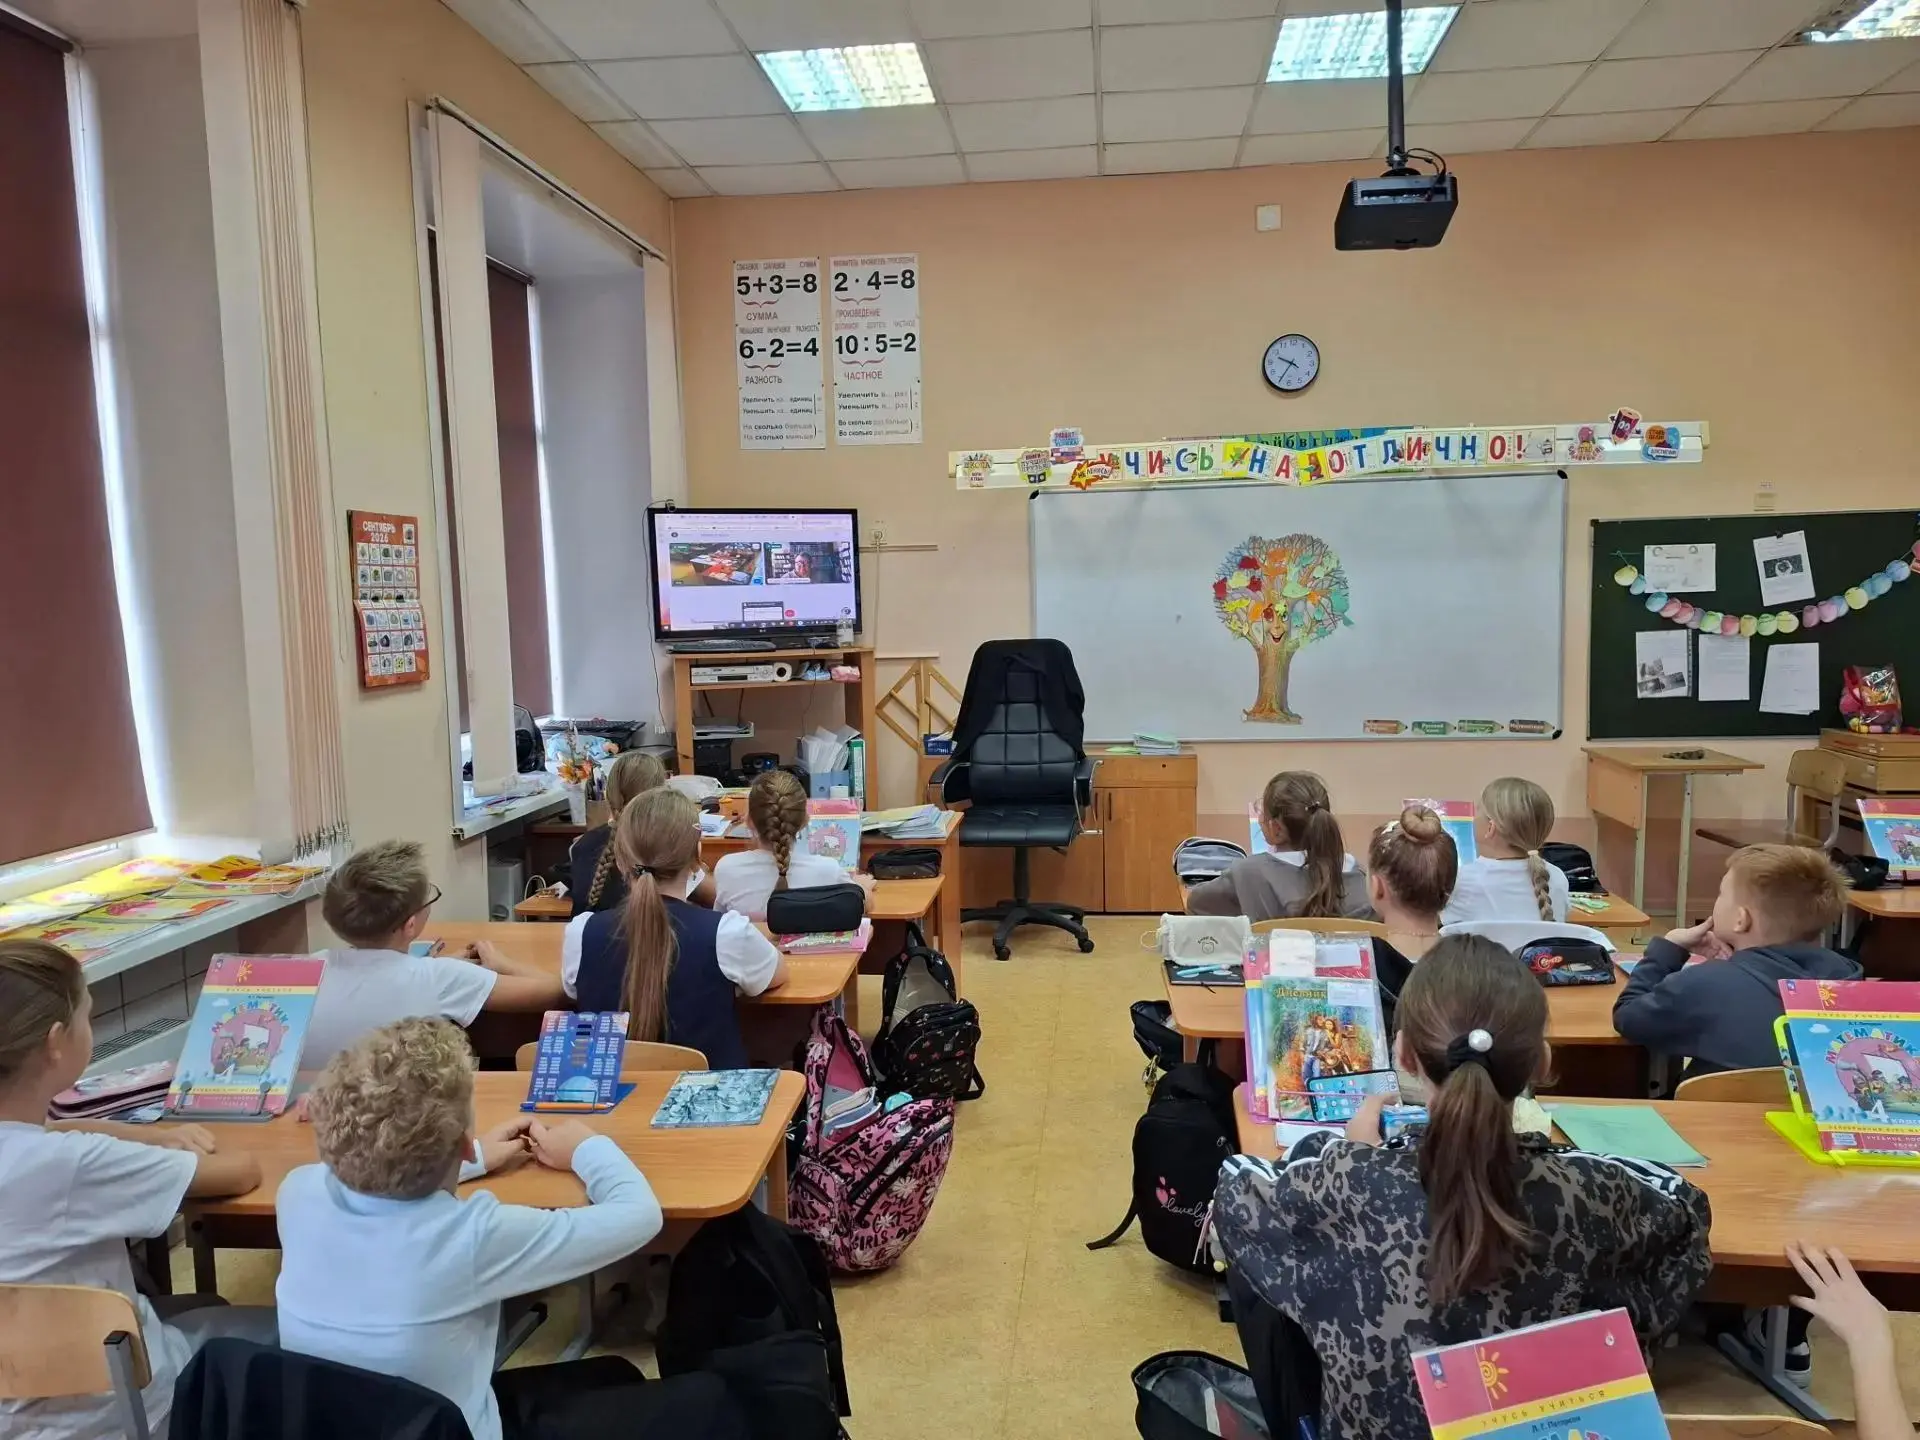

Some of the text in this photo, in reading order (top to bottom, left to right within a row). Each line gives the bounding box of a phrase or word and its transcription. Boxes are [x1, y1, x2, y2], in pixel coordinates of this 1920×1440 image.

[737, 273, 817, 295] 5+3=8
[746, 312, 778, 320] СУММА
[740, 337, 819, 359] 6-2=4
[745, 376, 783, 384] РАЗНОСТЬ
[844, 371, 883, 380] ЧАСТНОЕ
[838, 391, 879, 399] Увеличить
[1329, 434, 1523, 474] ОТЛИЧНО!
[363, 520, 396, 533] СЕНТЯБРЬ
[1275, 986, 1327, 999] Дневник
[1162, 1197, 1206, 1228] lovely
[851, 1230, 889, 1251] GIRLS
